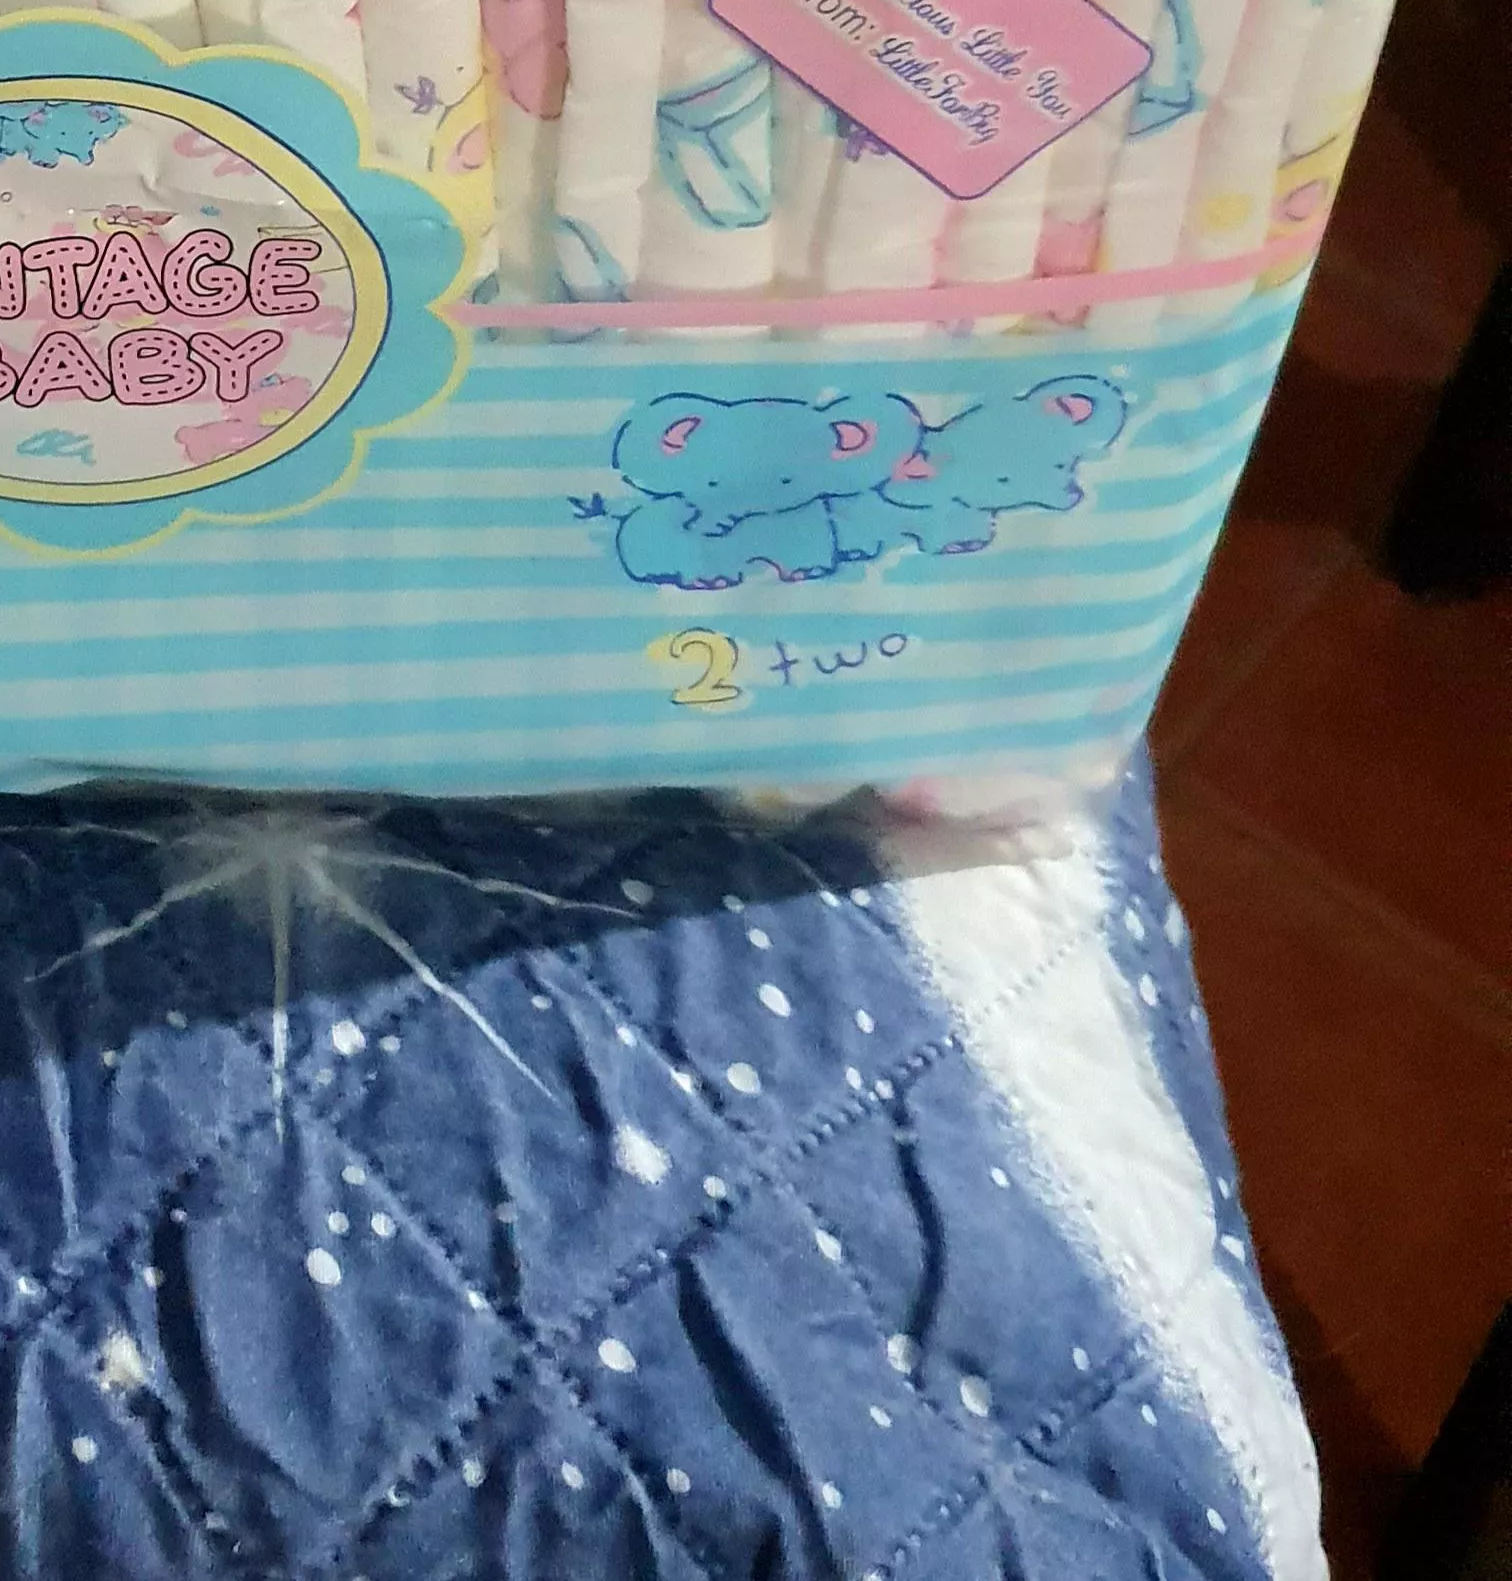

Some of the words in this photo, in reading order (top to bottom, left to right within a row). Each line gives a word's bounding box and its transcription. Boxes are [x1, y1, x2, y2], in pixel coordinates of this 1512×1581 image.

[959, 28, 1034, 80] Little
[1026, 70, 1075, 121] You
[669, 627, 741, 705] 2
[770, 633, 907, 685] two
